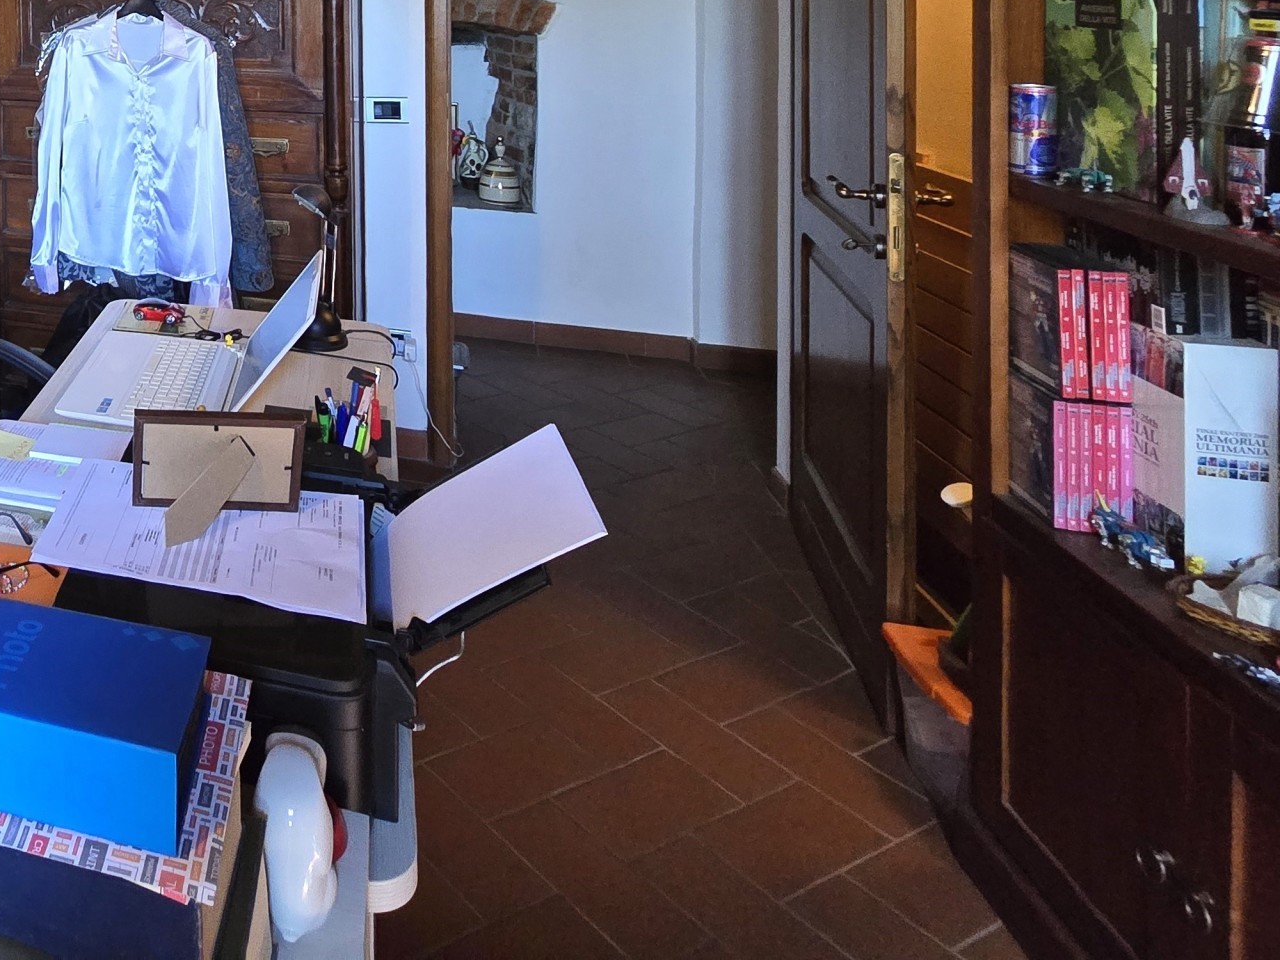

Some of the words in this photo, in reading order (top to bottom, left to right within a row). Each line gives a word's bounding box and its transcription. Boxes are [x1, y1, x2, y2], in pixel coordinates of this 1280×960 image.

[1196, 433, 1269, 448] MEMORIAL
[1196, 442, 1269, 456] ULTIMANIA
[199, 726, 219, 765] PHOTO
